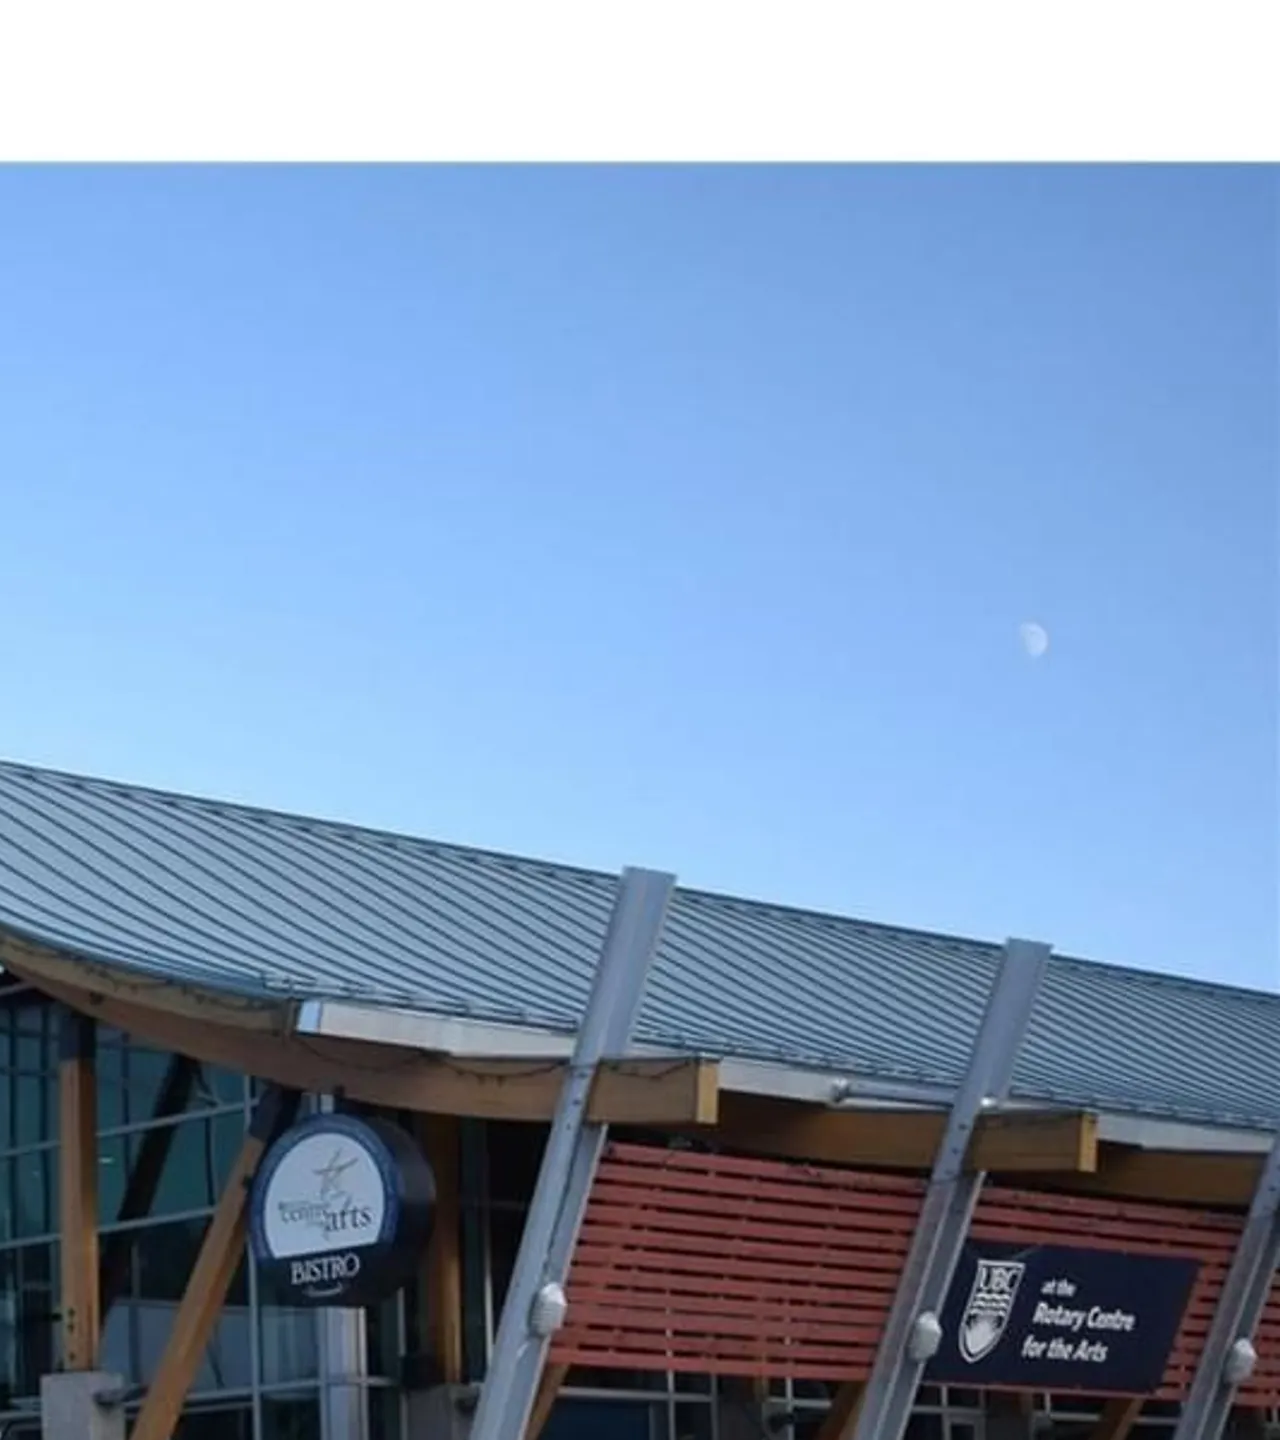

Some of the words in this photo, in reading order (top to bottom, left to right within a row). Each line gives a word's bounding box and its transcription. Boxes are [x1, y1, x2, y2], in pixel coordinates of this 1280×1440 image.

[291, 1253, 361, 1285] BISTRO
[979, 1267, 1019, 1293] UBC
[1057, 1278, 1077, 1297] the
[1033, 1302, 1086, 1332] Rotary
[1087, 1306, 1136, 1331] Centre
[1021, 1334, 1045, 1358] for
[1046, 1336, 1073, 1360] the
[1073, 1340, 1109, 1362] Arts
